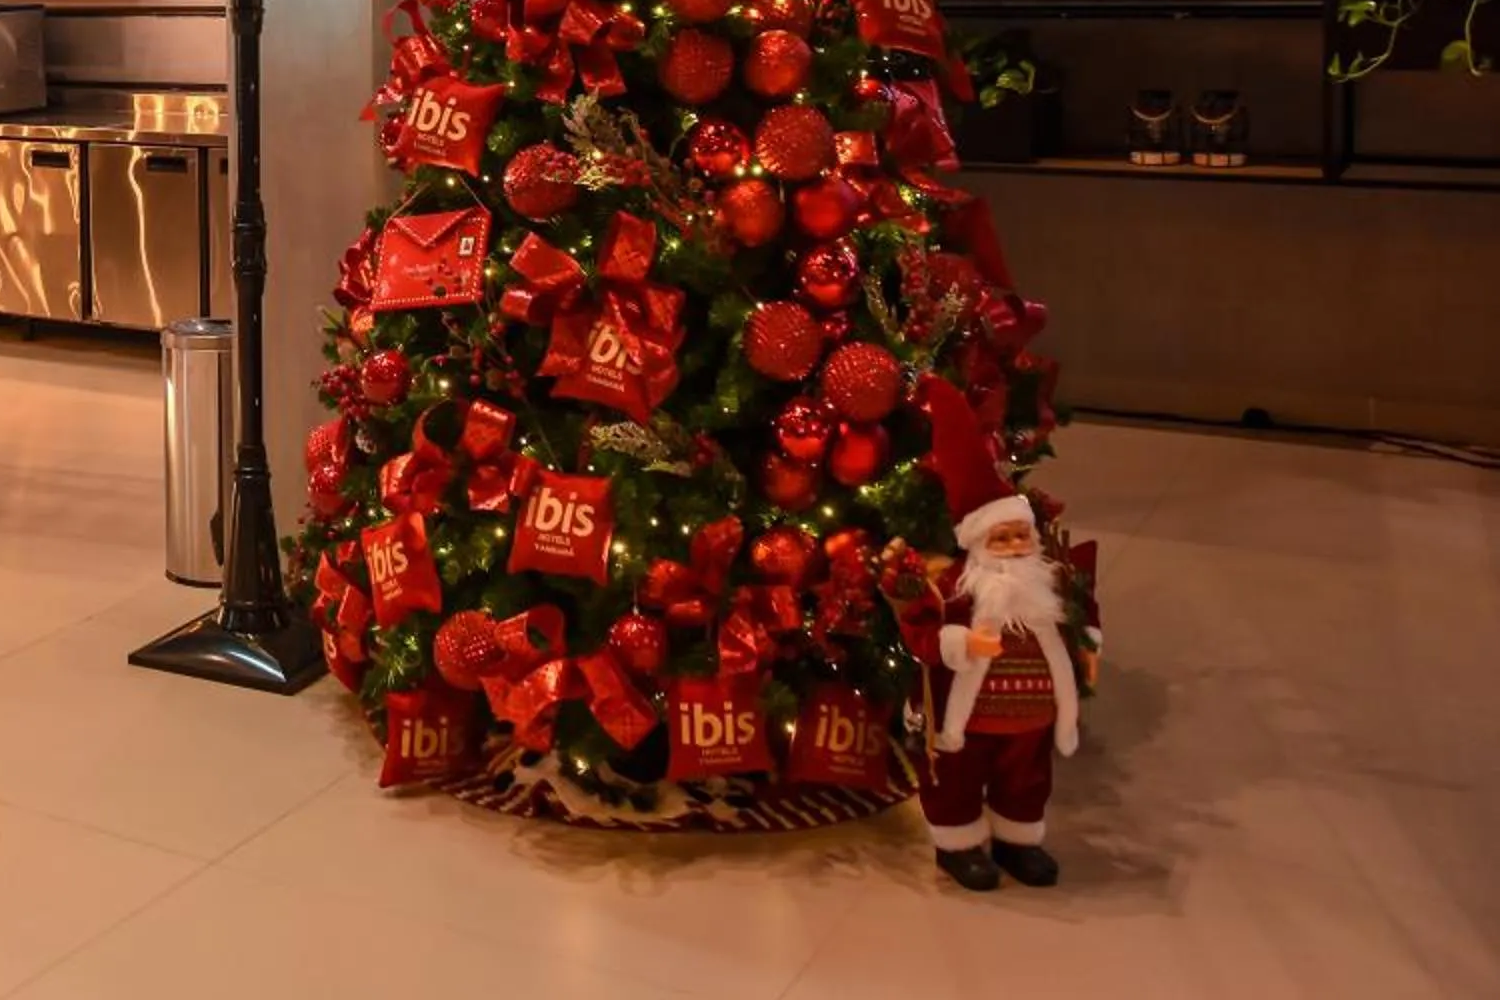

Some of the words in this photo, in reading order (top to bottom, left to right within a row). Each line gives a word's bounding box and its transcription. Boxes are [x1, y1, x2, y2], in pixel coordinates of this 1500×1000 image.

[407, 87, 471, 141] ibis
[525, 487, 595, 537] ibis
[366, 535, 409, 584] ibis
[400, 715, 465, 758] ibis
[679, 700, 756, 747] ibis
[814, 704, 882, 756] ibis
